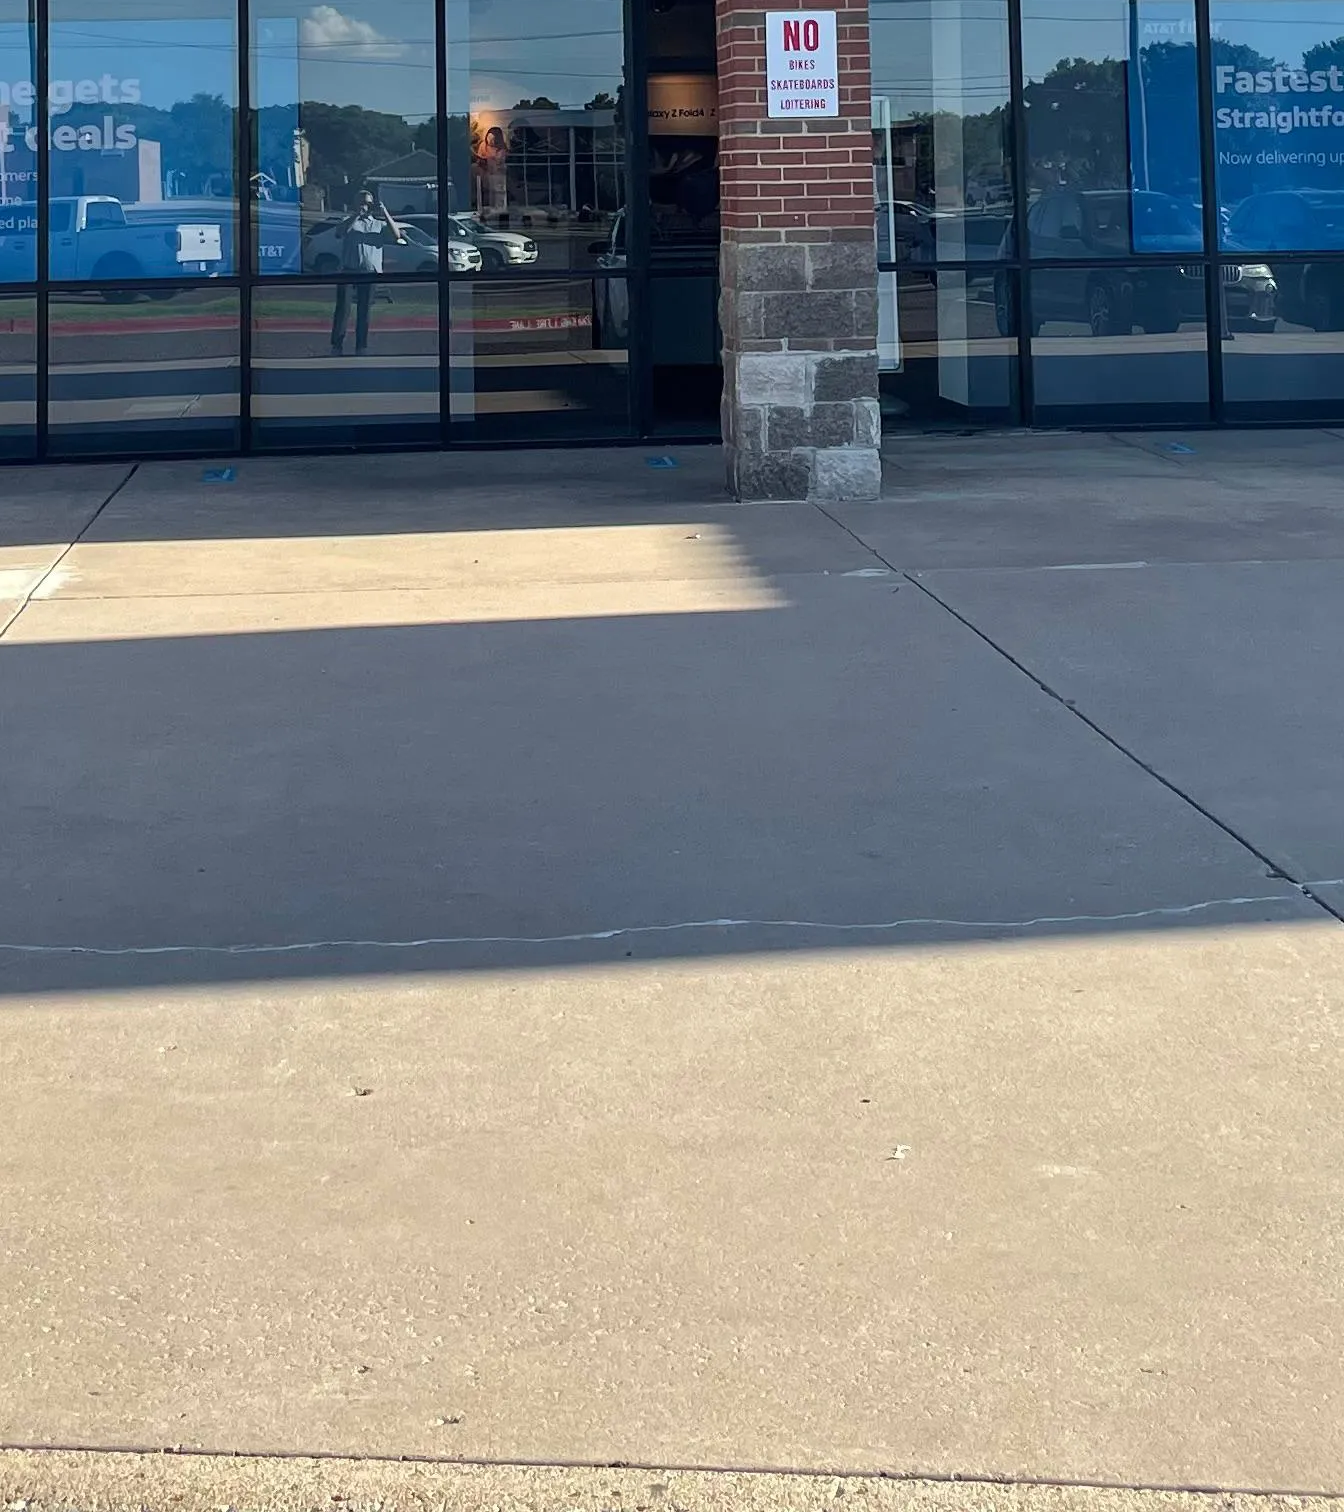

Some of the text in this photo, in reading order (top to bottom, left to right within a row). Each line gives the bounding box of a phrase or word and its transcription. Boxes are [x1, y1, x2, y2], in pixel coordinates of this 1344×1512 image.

[783, 19, 819, 52] NO
[788, 59, 816, 70] BIKES
[770, 78, 835, 90] SKATEBOARDS
[1215, 65, 1344, 94] Fastest
[47, 73, 142, 116] gets
[780, 99, 826, 110] LOITERING
[679, 108, 705, 117] Fold4
[1219, 151, 1251, 165] Now
[1255, 149, 1326, 167] delivering
[17, 216, 38, 231] pla
